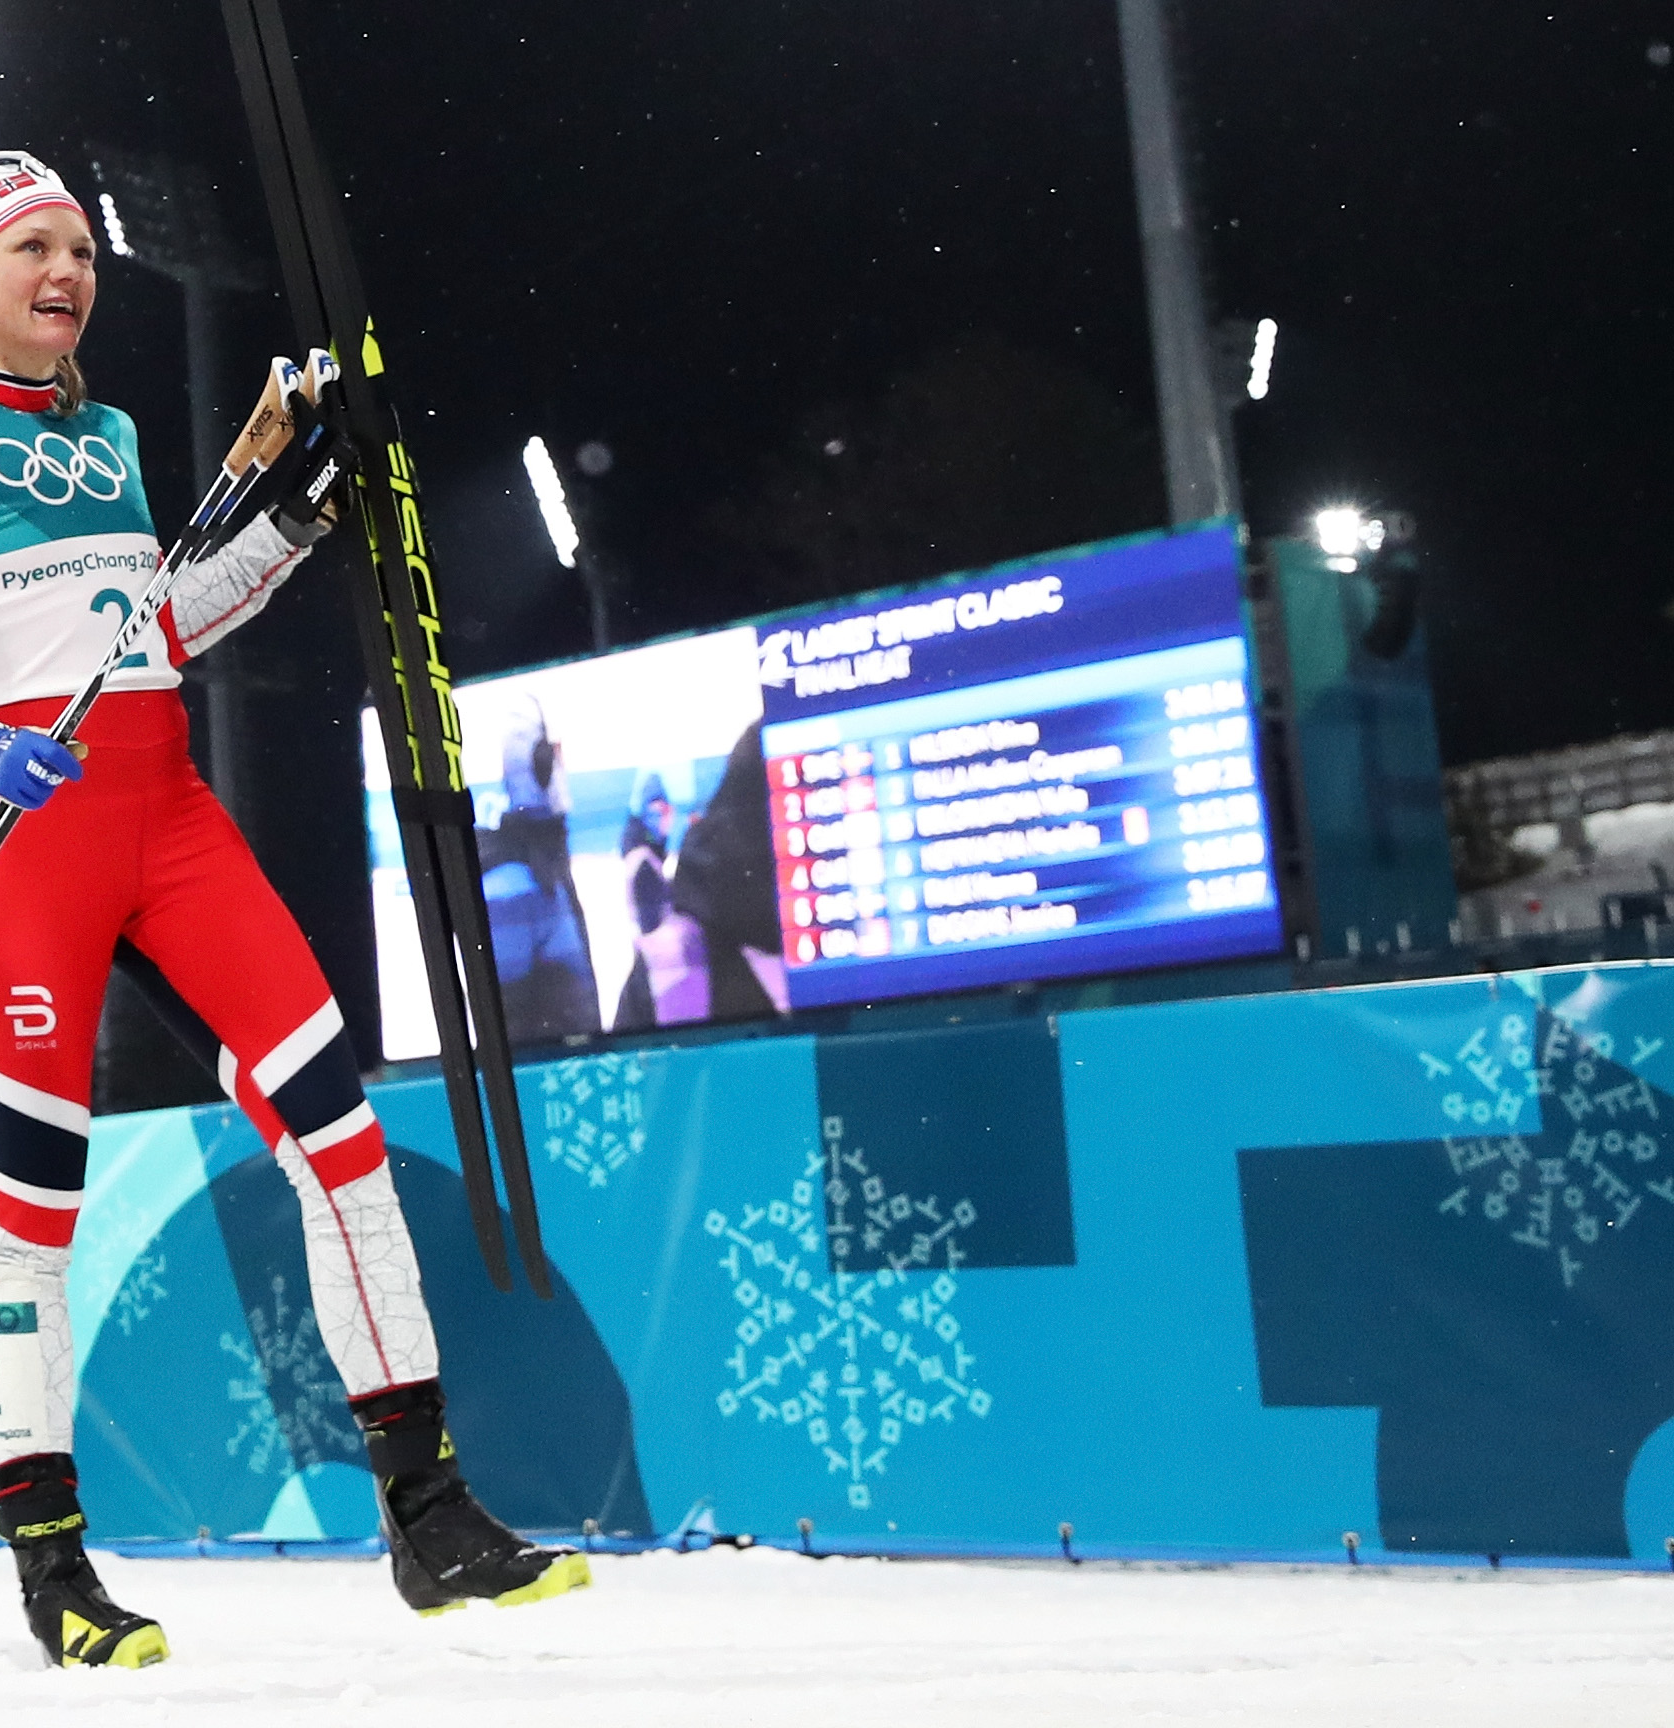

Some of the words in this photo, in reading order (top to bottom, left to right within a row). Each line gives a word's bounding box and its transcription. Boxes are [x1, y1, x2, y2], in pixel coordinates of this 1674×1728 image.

[306, 457, 340, 505] SWIX
[1, 552, 138, 590] PyeongChang
[90, 588, 149, 670] 2
[387, 441, 468, 793] FISCHER
[15, 1512, 84, 1538] FISCHER
